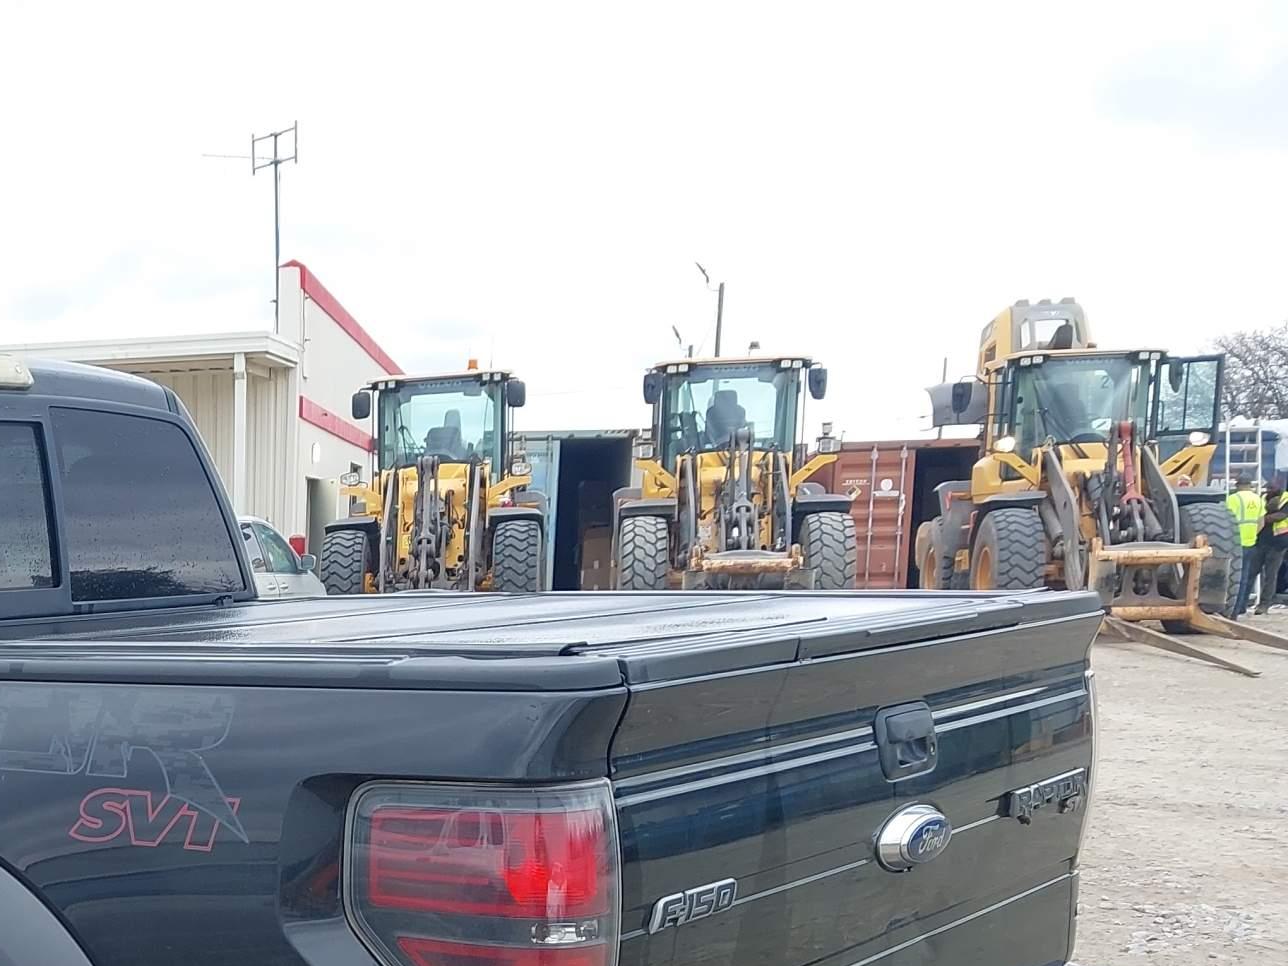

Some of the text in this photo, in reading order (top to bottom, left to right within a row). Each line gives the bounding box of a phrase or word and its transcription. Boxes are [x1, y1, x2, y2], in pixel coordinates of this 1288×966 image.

[1010, 767, 1087, 818] RAPTOR
[69, 787, 240, 851] SVT
[918, 823, 946, 855] Ford
